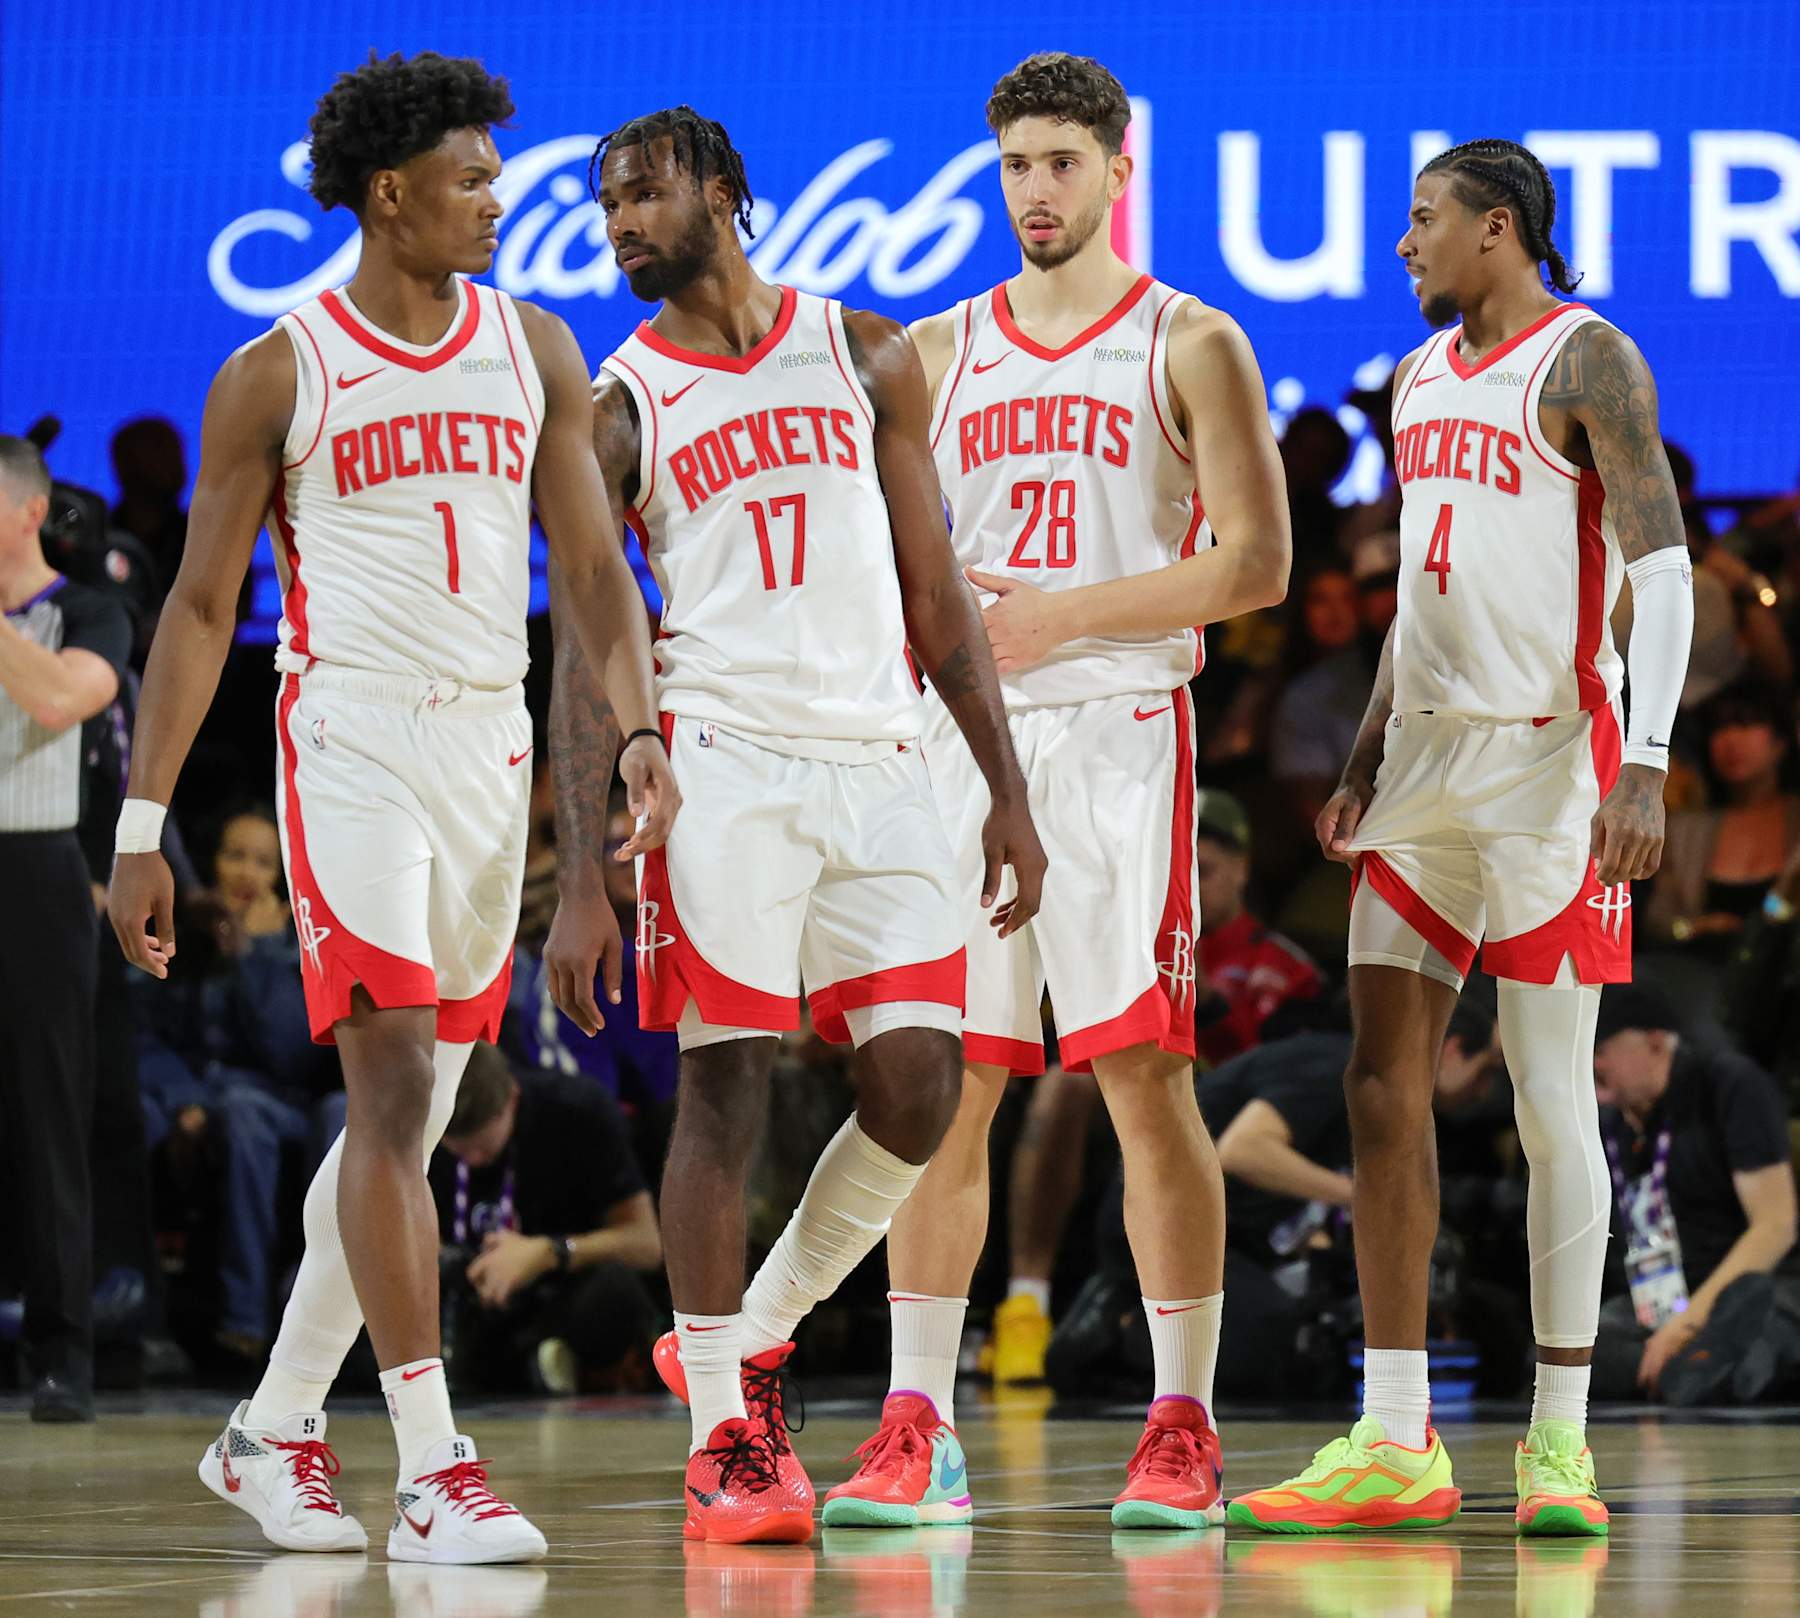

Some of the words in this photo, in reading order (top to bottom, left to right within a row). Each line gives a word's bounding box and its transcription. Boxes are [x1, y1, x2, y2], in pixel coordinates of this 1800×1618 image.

[1217, 130, 1800, 302] UTR
[332, 411, 526, 499] ROCKETS
[667, 406, 860, 513] ROCKETS
[959, 394, 1134, 476] ROCKETS
[433, 501, 461, 594] 1
[743, 492, 807, 591] 17
[1006, 479, 1077, 569] 28
[1423, 503, 1453, 596] 4
